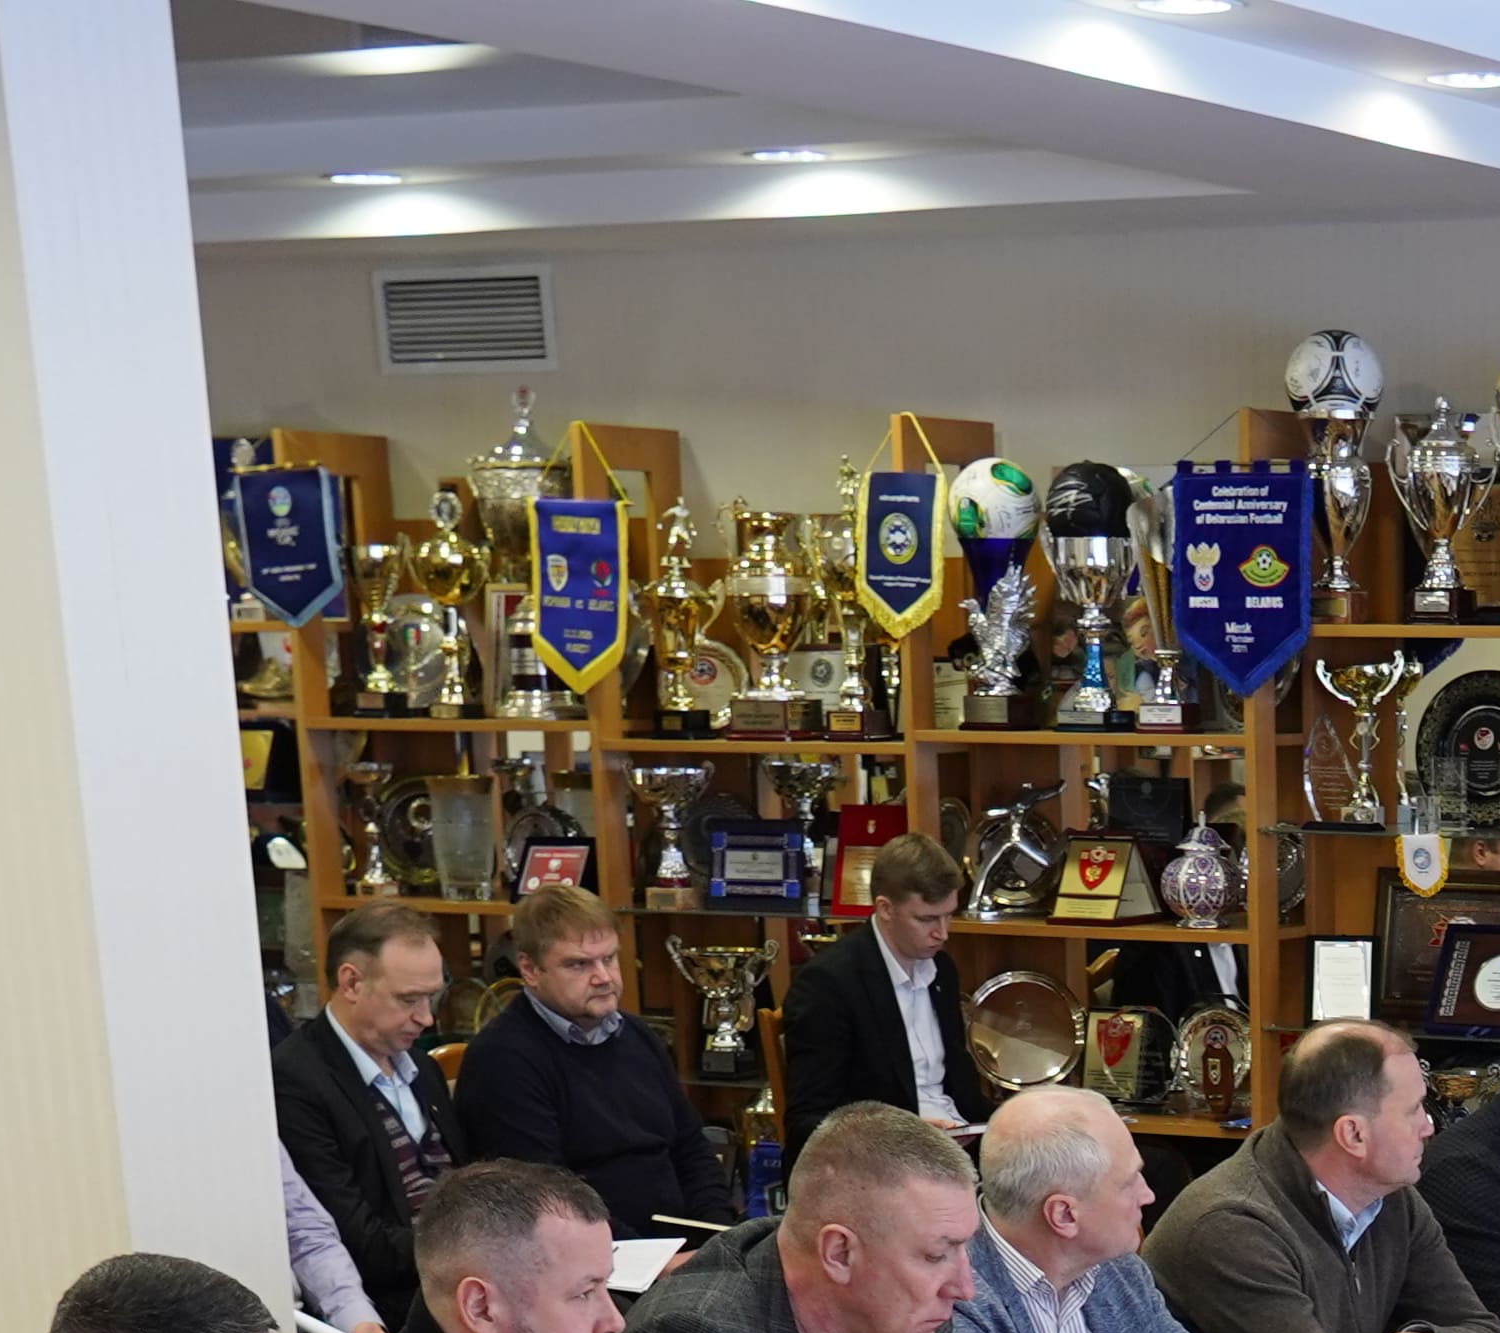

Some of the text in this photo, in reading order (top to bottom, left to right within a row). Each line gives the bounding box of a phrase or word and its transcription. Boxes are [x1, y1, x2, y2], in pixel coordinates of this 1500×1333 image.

[1212, 485, 1269, 497] Celebration of
[1192, 499, 1288, 513] Centennial Anniversary
[1195, 513, 1204, 525] of
[1250, 513, 1284, 525] Football
[1245, 596, 1284, 609] BELARUS
[1225, 621, 1252, 634] Minsk
